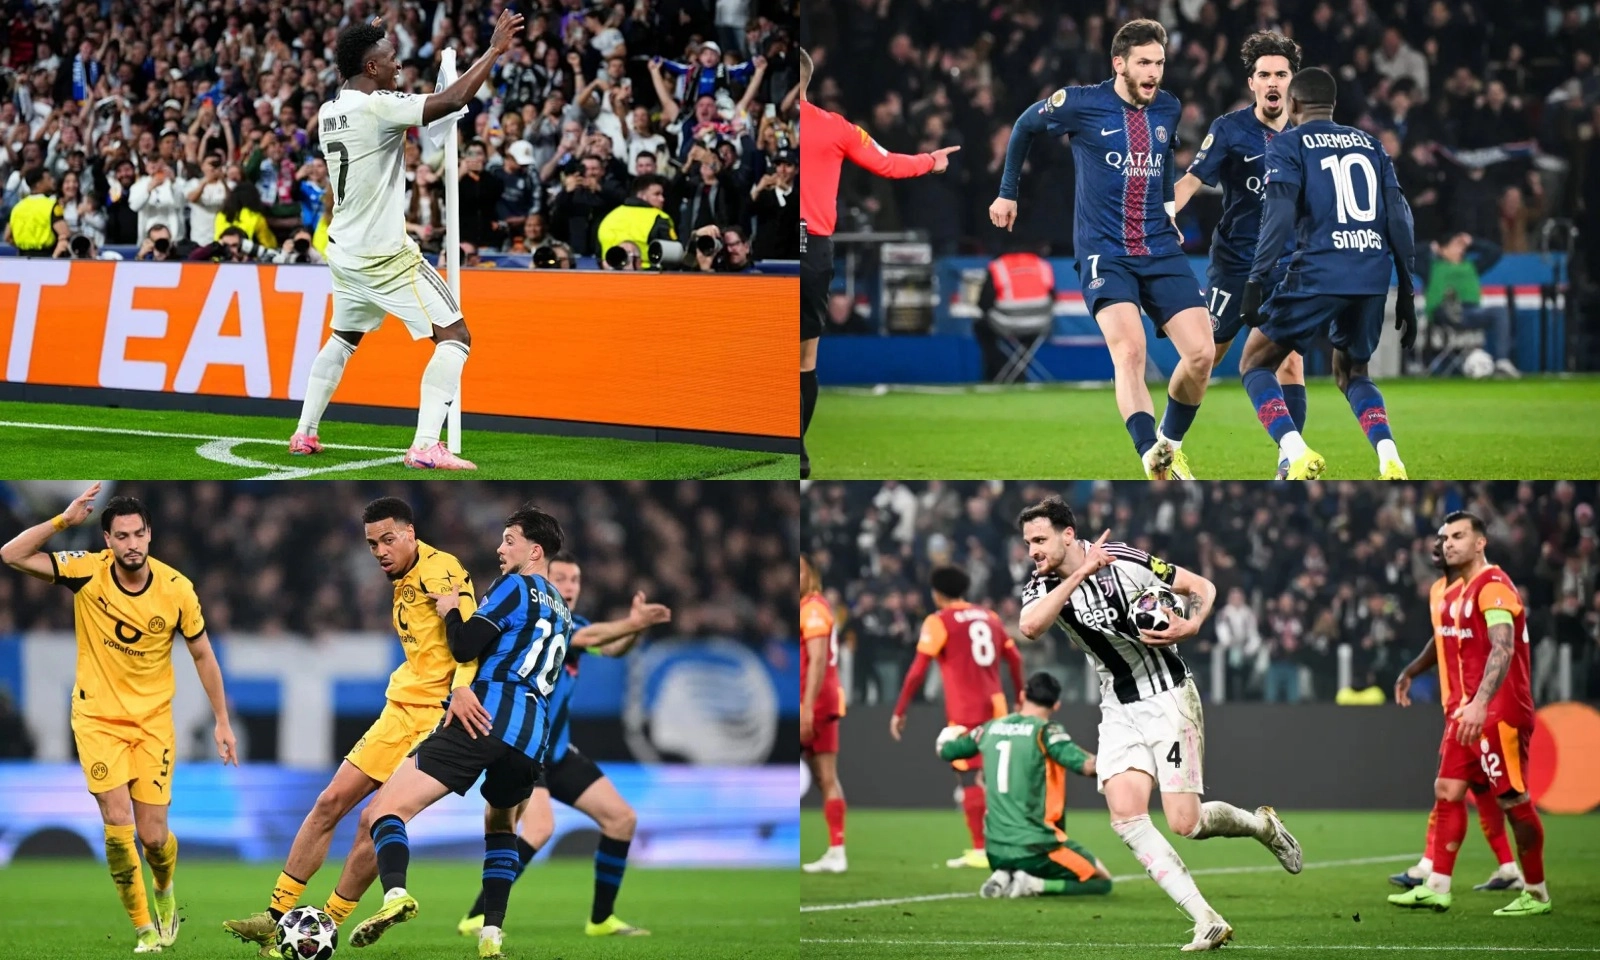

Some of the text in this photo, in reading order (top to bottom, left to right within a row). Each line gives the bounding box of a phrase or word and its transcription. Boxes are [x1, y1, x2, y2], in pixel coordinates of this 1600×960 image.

[338, 114, 350, 130] JR.
[326, 141, 349, 206] 7
[1105, 151, 1163, 169] QATAR
[1121, 168, 1161, 177] AIRWAYS
[1320, 153, 1378, 224] 10
[1331, 228, 1383, 253] snipes
[1087, 254, 1101, 279] 7
[1209, 286, 1232, 317] 17
[530, 588, 573, 625] SAMARD
[1073, 606, 1119, 627] Jeep
[103, 638, 146, 658] vodafone
[517, 617, 567, 697] 10
[968, 620, 995, 667] 8
[995, 740, 1012, 794] 1
[1166, 741, 1182, 769] 4
